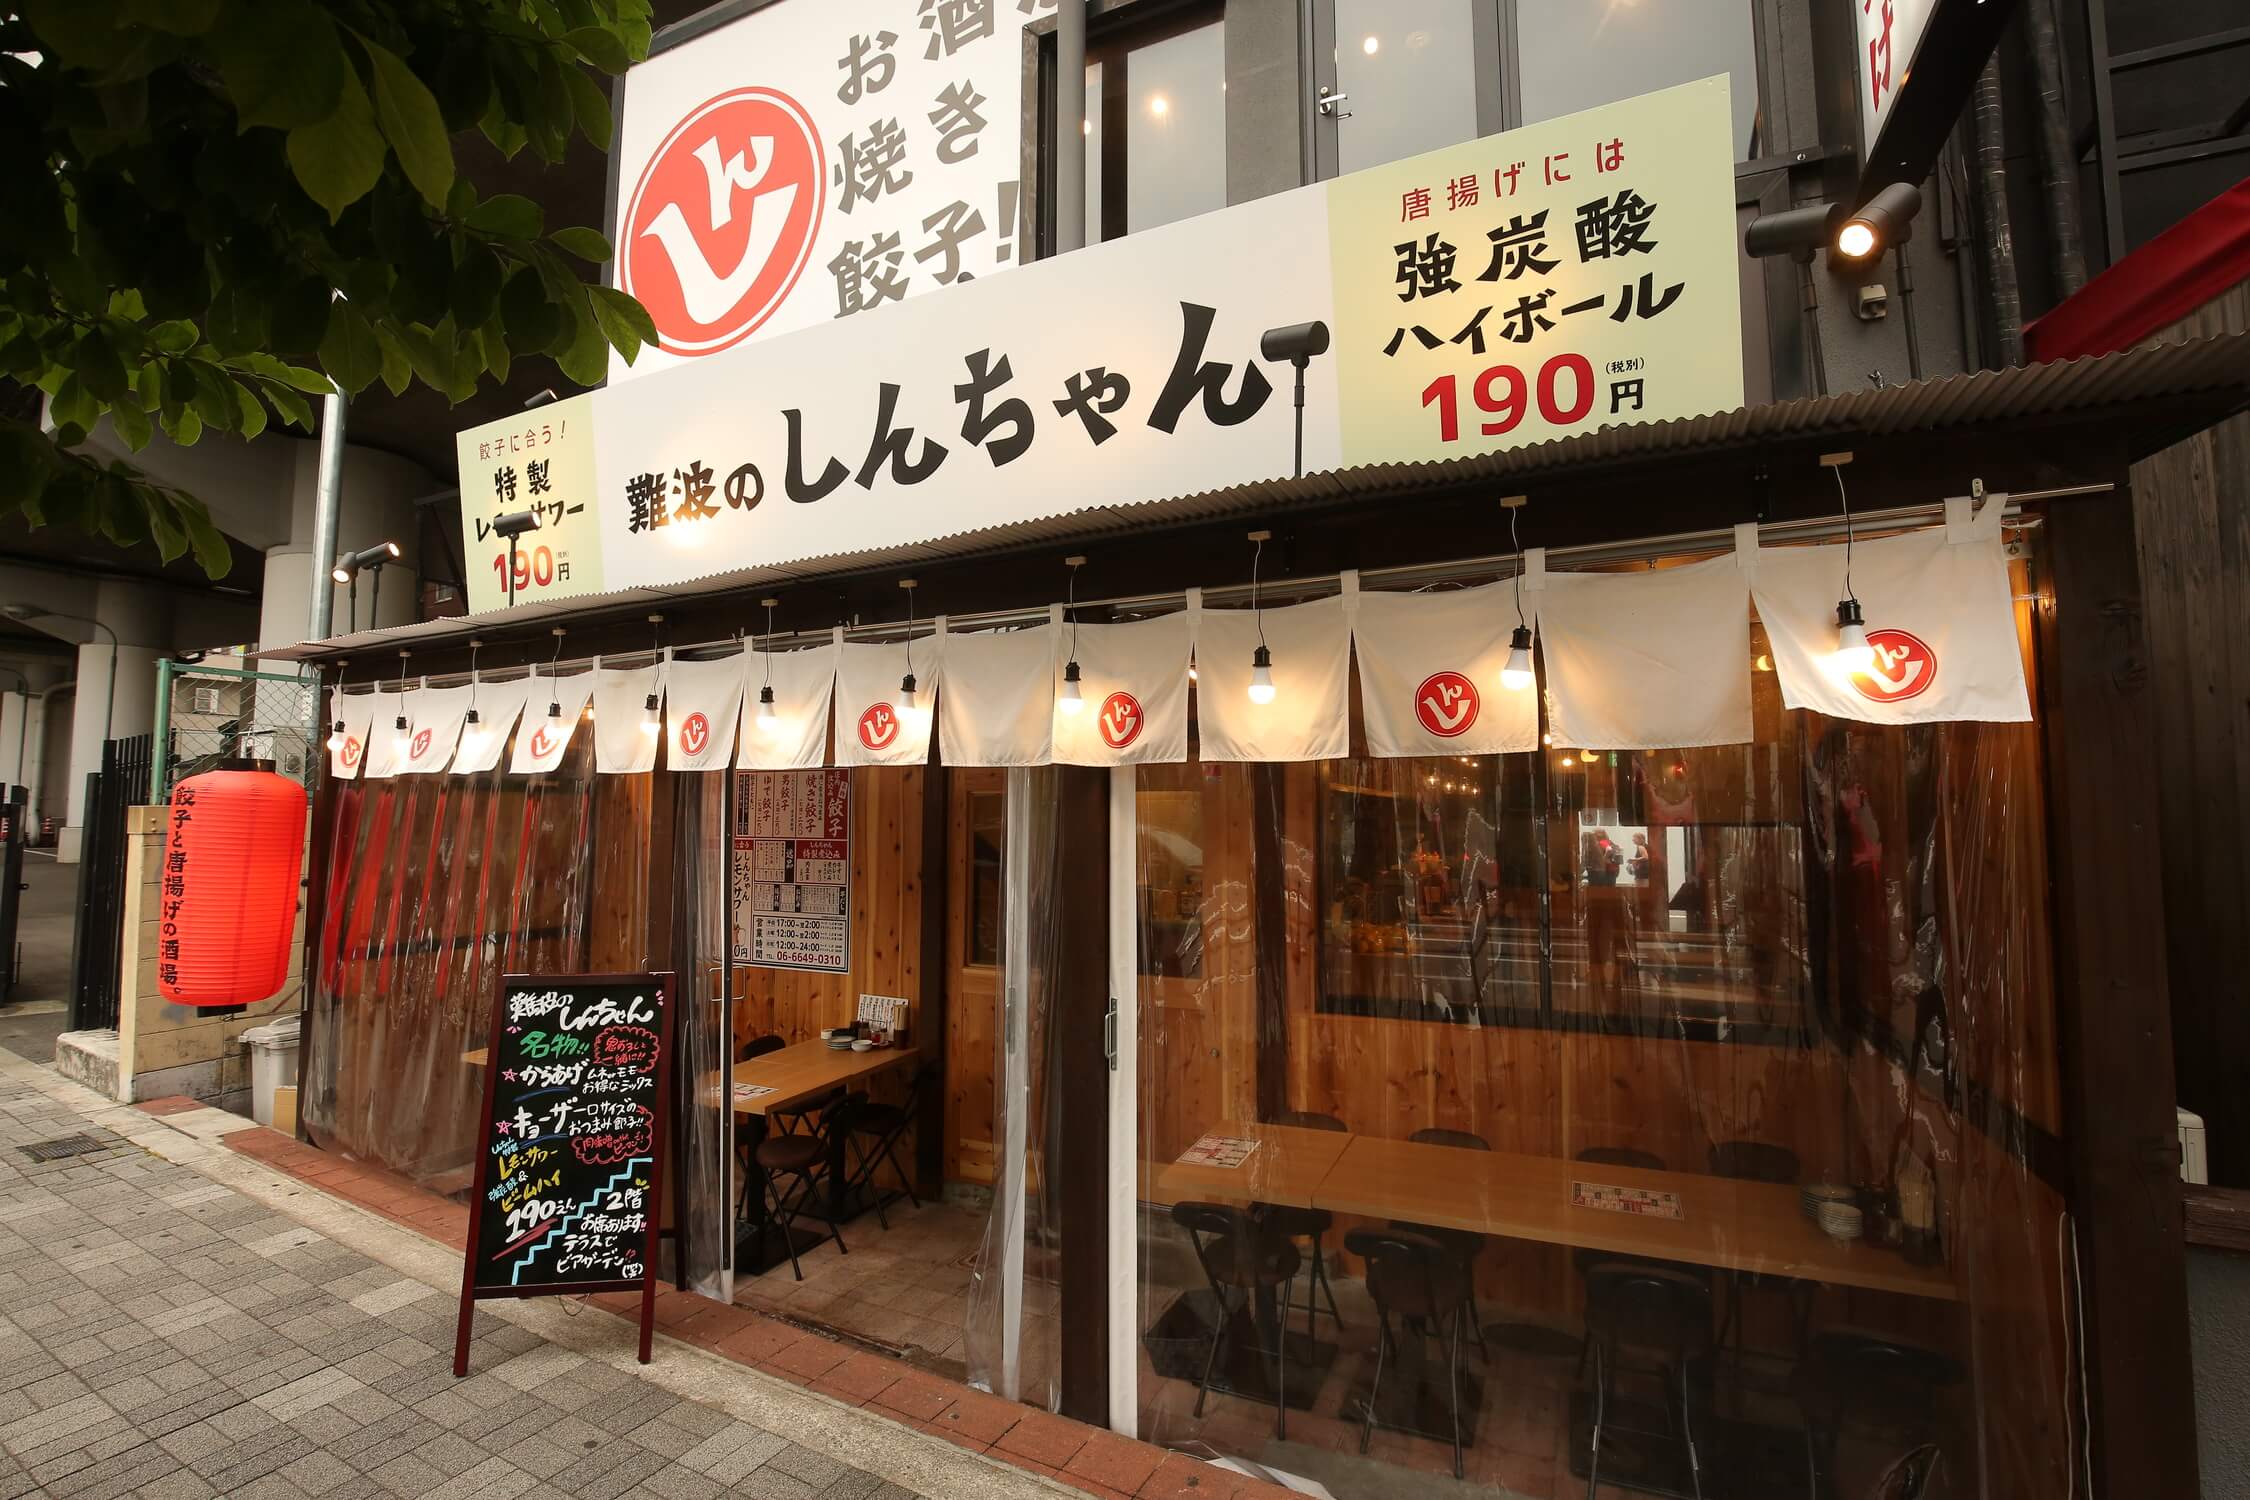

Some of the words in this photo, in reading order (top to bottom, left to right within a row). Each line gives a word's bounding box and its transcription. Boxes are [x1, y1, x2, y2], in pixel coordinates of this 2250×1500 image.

[836, 0, 1058, 106] お酒
[833, 79, 988, 215] 焼き
[1401, 137, 1627, 224] 唐揚げには
[1393, 188, 1659, 303] 強炭酸
[1383, 271, 1686, 358] ハイボール
[494, 458, 551, 503] 特製
[475, 500, 584, 543] レサワー
[160, 785, 196, 995] 餃子と唐揚げの酒場。
[777, 951, 841, 965] 06-6649-0310
[520, 1058, 590, 1087] からあげ
[582, 1077, 654, 1094] お得なミックス
[606, 1188, 642, 1210] 2階
[562, 1234, 618, 1253] テラスで
